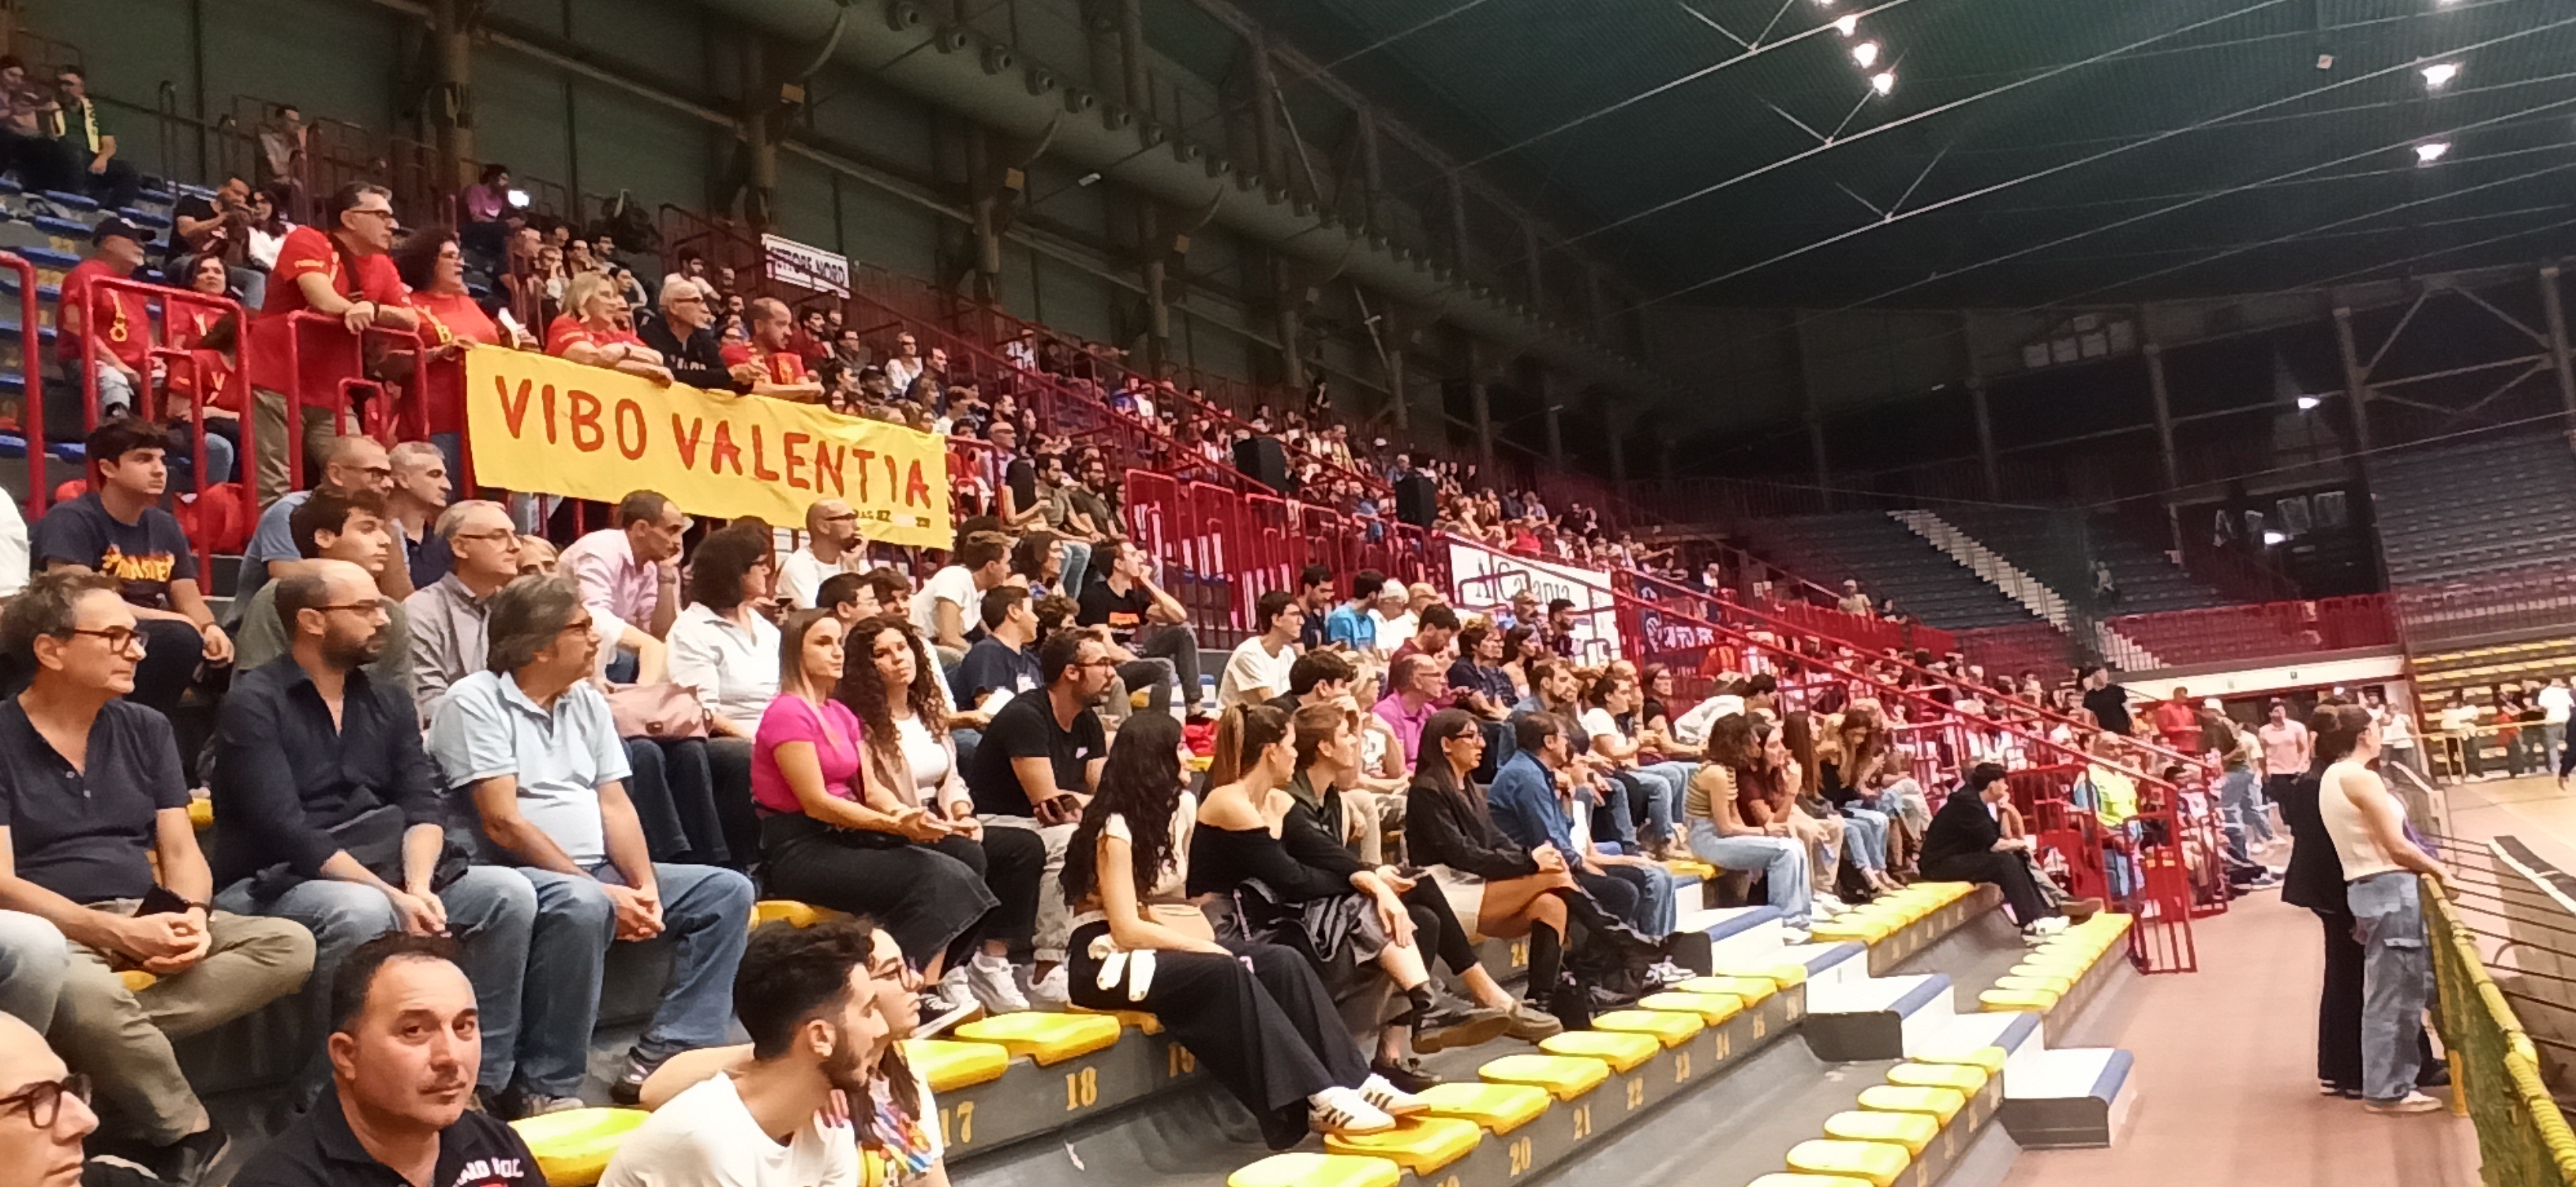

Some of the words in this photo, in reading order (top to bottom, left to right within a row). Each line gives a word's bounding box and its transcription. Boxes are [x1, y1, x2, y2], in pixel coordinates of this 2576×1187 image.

[495, 375, 647, 460] VIBO
[672, 413, 931, 509] VALENTIA
[1065, 1066, 1098, 1111] 18
[940, 1101, 975, 1148] 17
[1573, 1103, 1592, 1142] 21
[1509, 1136, 1532, 1178] 20
